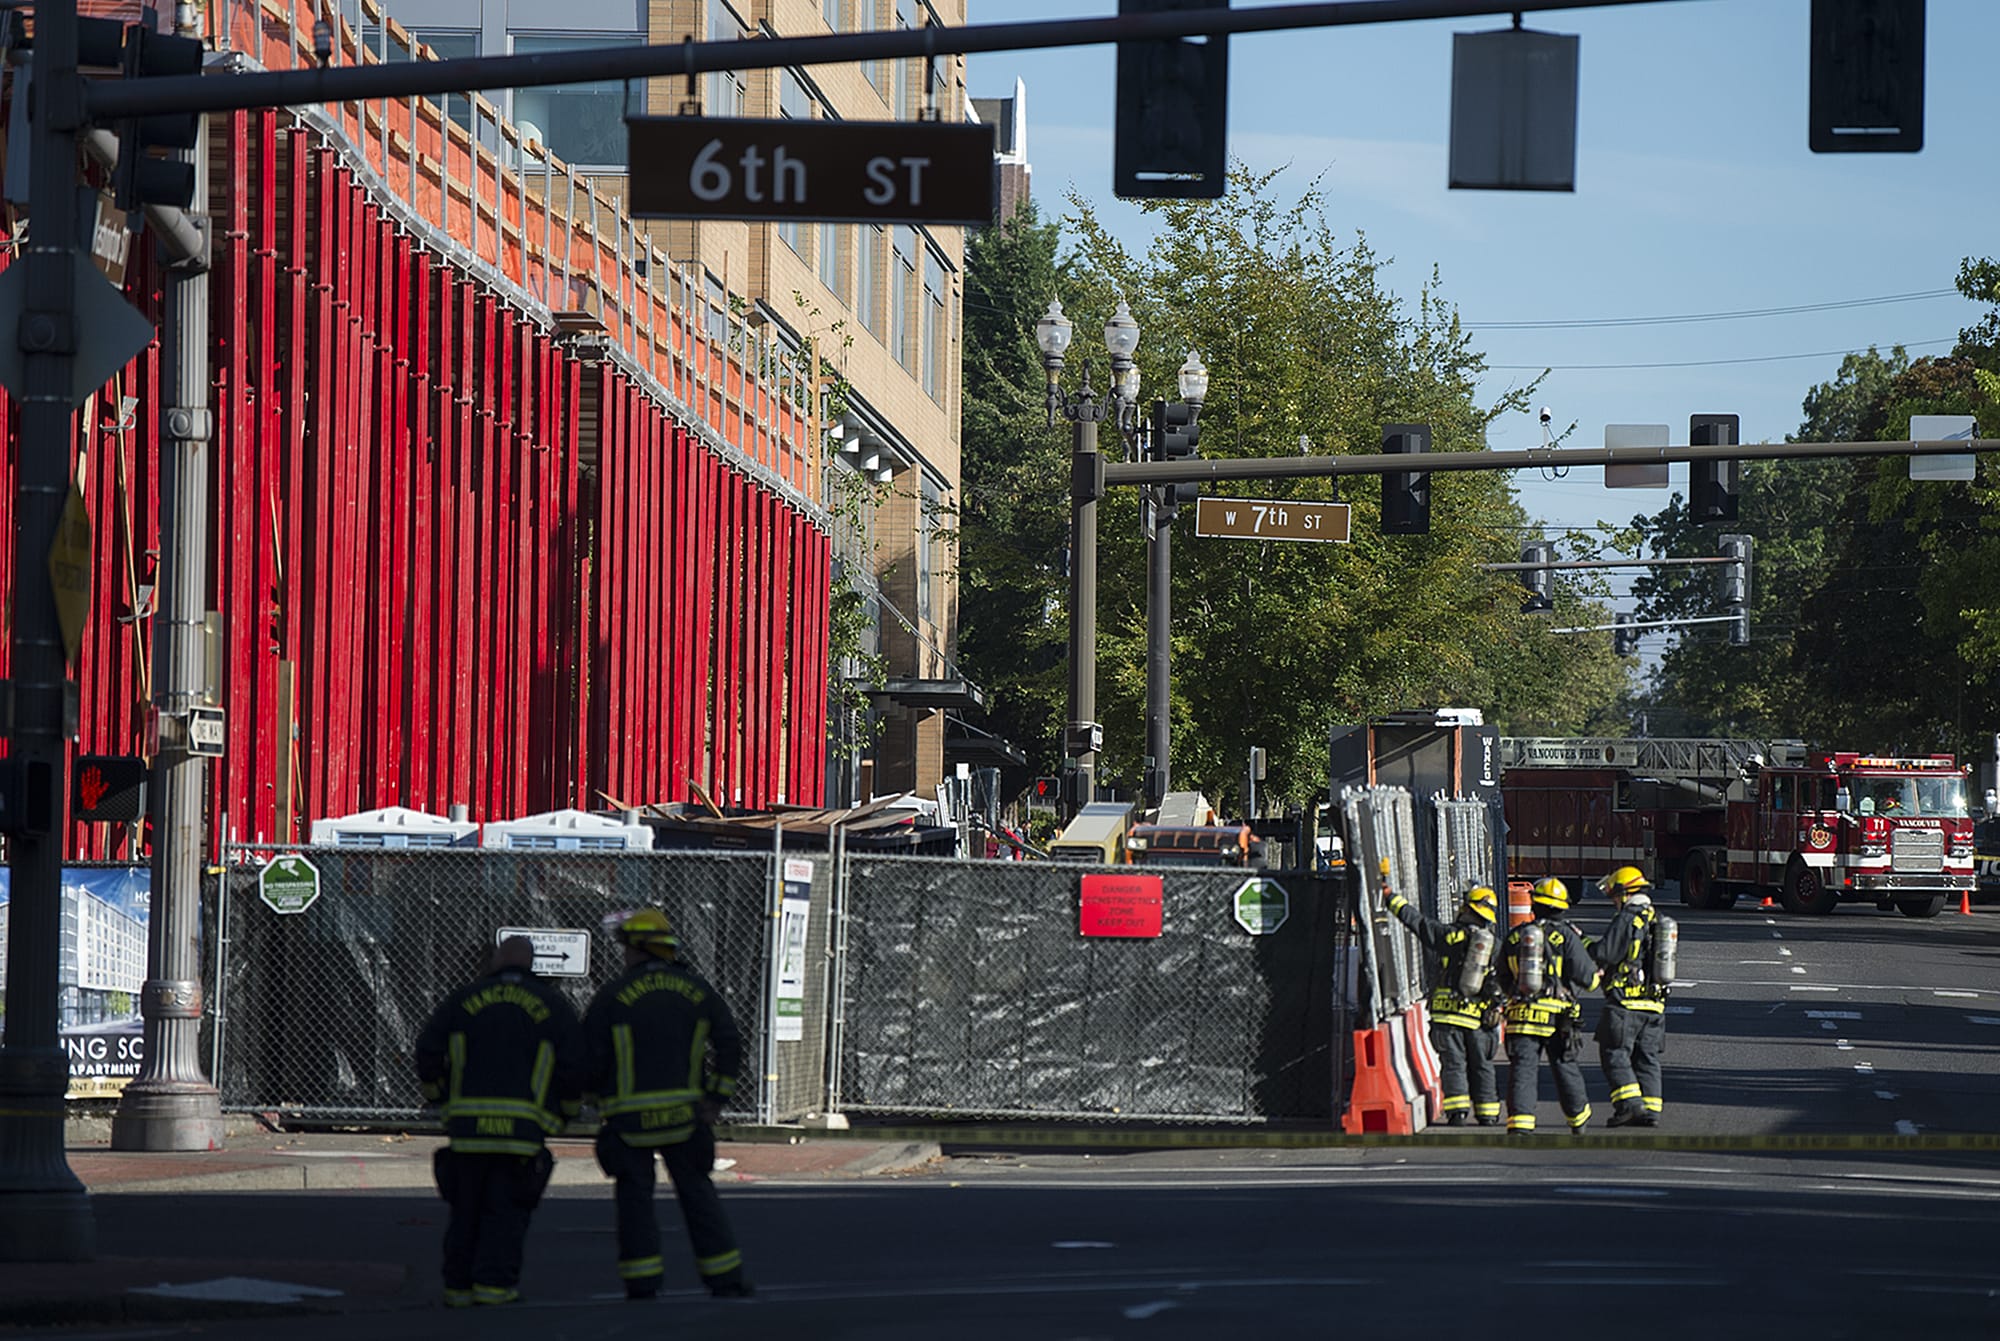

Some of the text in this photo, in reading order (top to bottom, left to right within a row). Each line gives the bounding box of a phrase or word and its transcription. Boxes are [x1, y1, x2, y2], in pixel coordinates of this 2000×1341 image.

[689, 138, 931, 206] 6th ST
[1225, 506, 1323, 533] W 7th ST
[1527, 747, 1600, 760] VANCOUVER FIRE
[1873, 819, 1884, 830] T1
[1899, 819, 1941, 828] VANCOUVER
[616, 971, 704, 1007] VANCOUVER
[462, 984, 550, 1024] VANCOUVER
